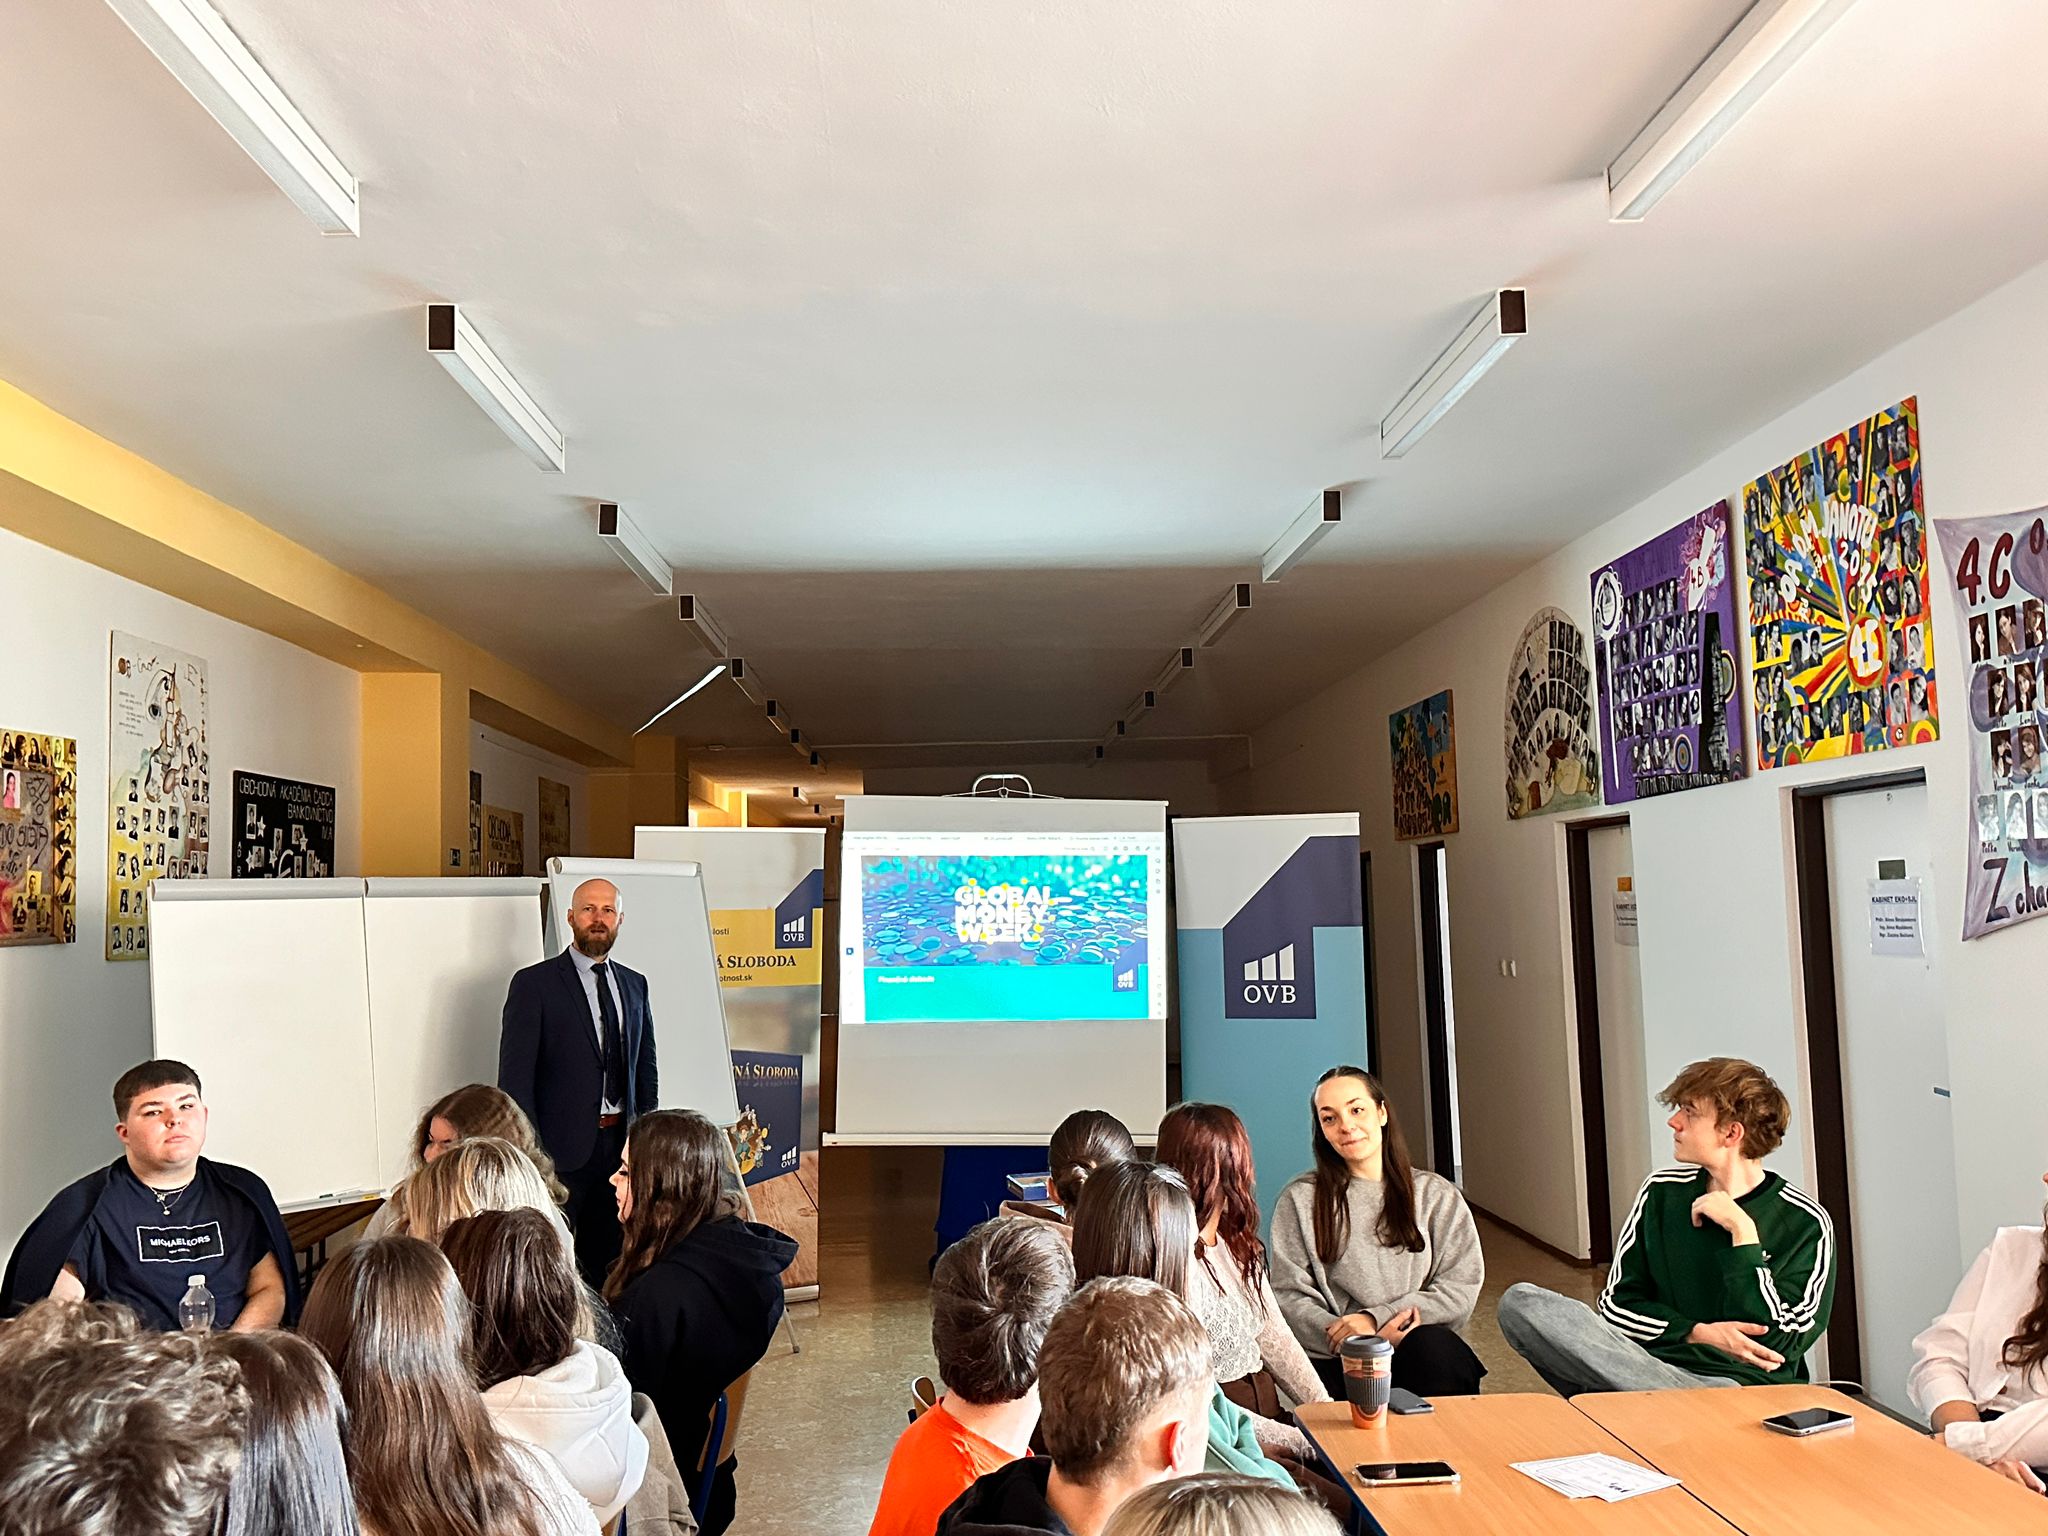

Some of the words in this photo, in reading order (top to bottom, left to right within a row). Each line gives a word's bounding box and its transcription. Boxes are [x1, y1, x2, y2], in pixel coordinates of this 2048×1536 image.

[240, 777, 277, 798] OBCHODNÁ
[280, 785, 311, 802] AKADÉMIA
[955, 885, 1053, 906] GLOBAL
[1983, 857, 2010, 923] Z
[2015, 860, 2048, 915] cha
[955, 904, 1049, 925] MONEY
[782, 932, 805, 942] OVB
[956, 922, 1044, 943] WEEK
[1243, 985, 1297, 1004] OVB
[781, 1159, 797, 1169] OVB
